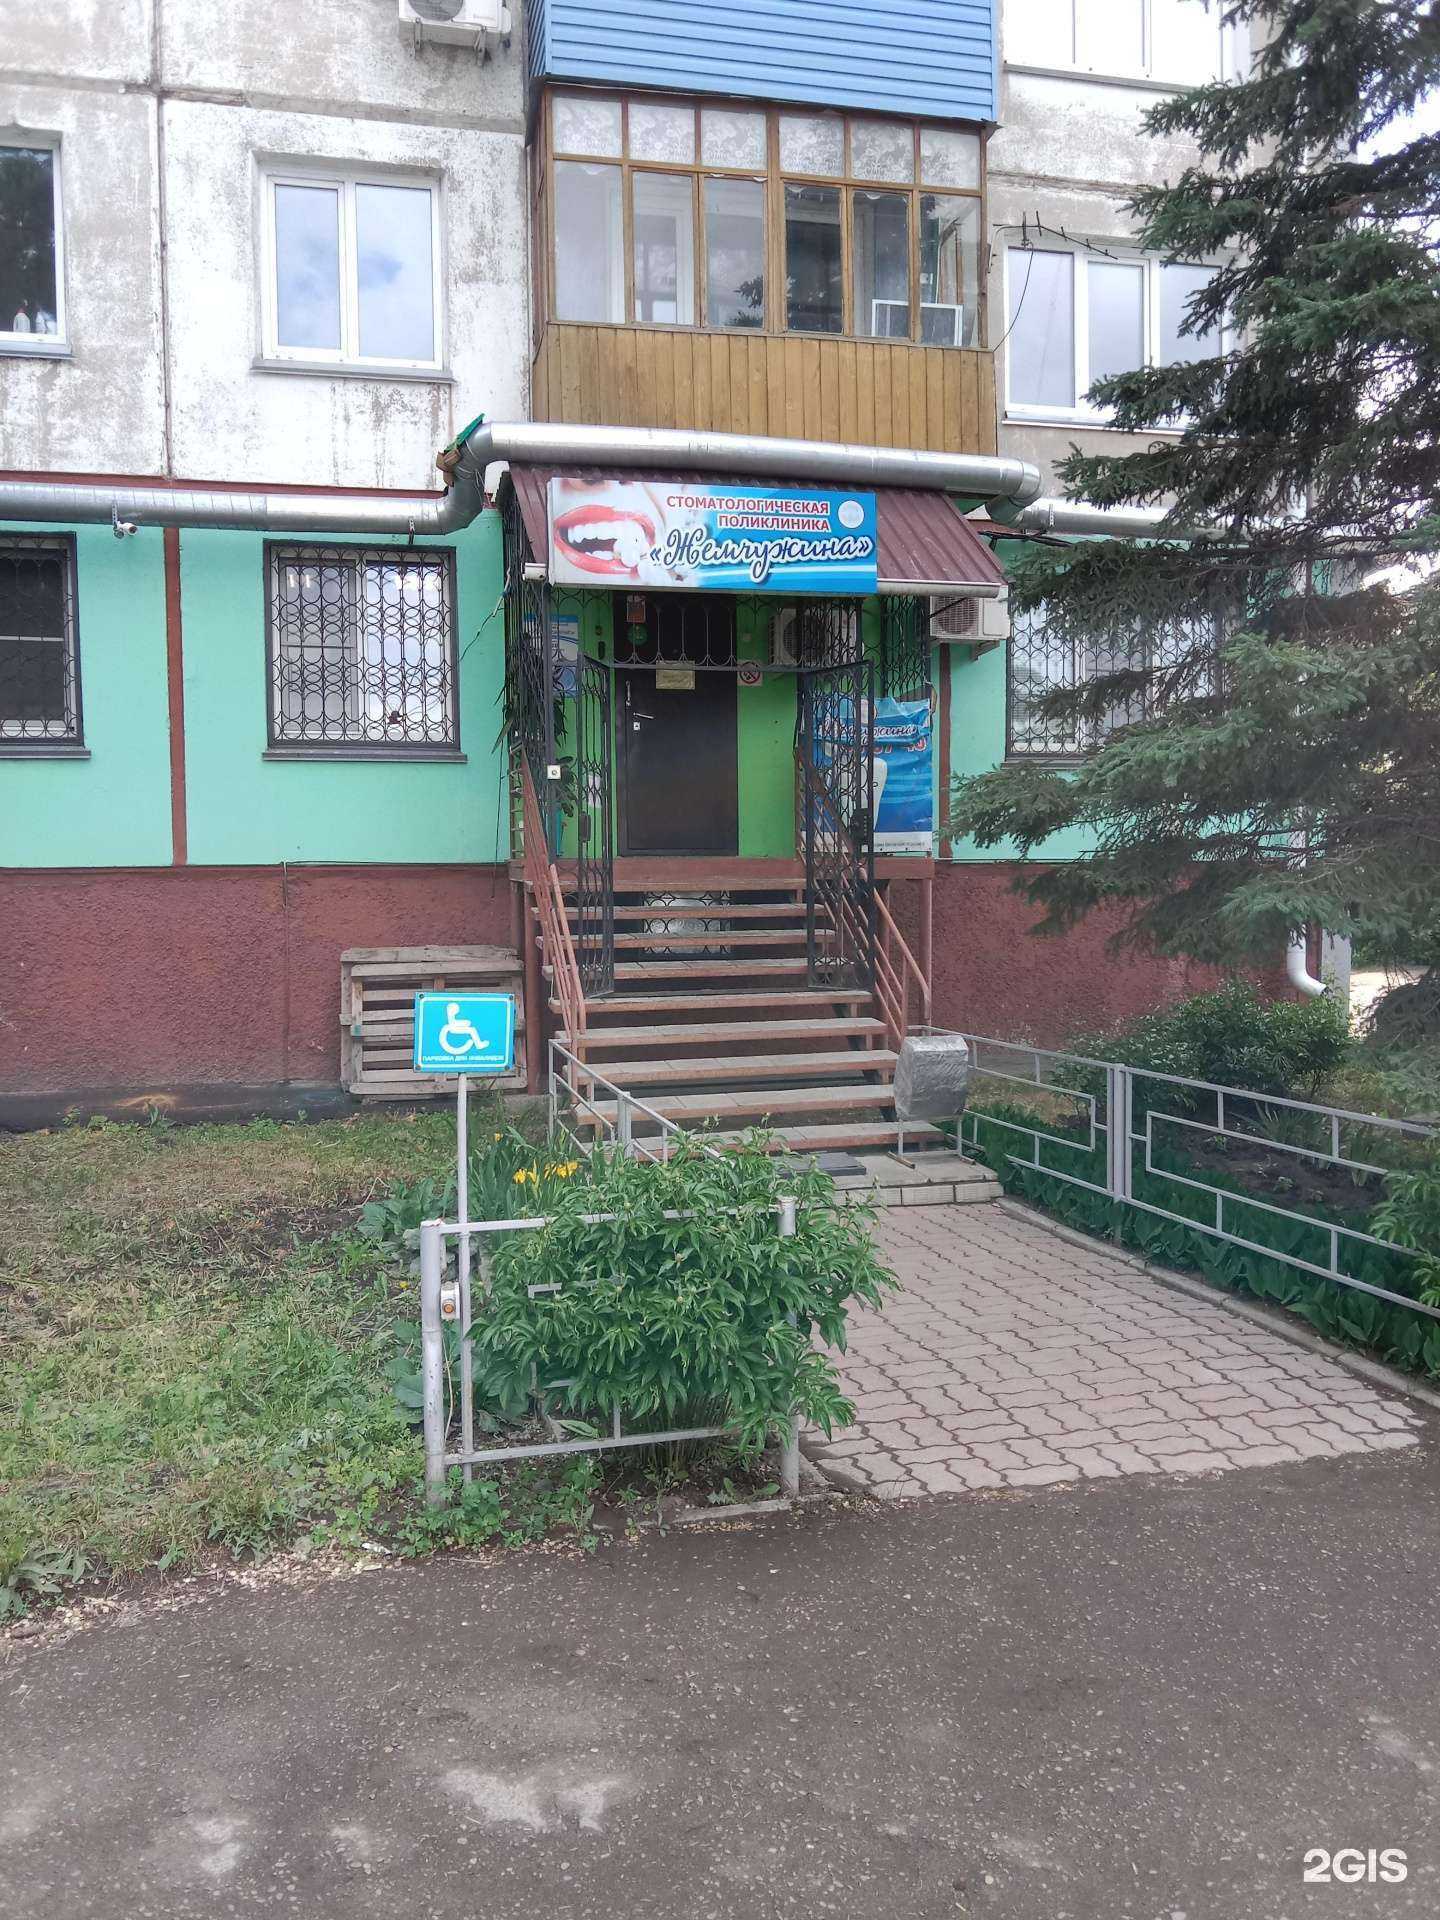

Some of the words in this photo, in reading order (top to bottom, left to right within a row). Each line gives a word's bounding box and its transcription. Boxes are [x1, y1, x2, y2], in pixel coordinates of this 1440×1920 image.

[667, 496, 829, 514] СТОМАТОЛОГИЧЕСКАЯ
[719, 515, 829, 531] ПОЛИКЛИНИКА
[649, 529, 870, 579] «Жемчужина»
